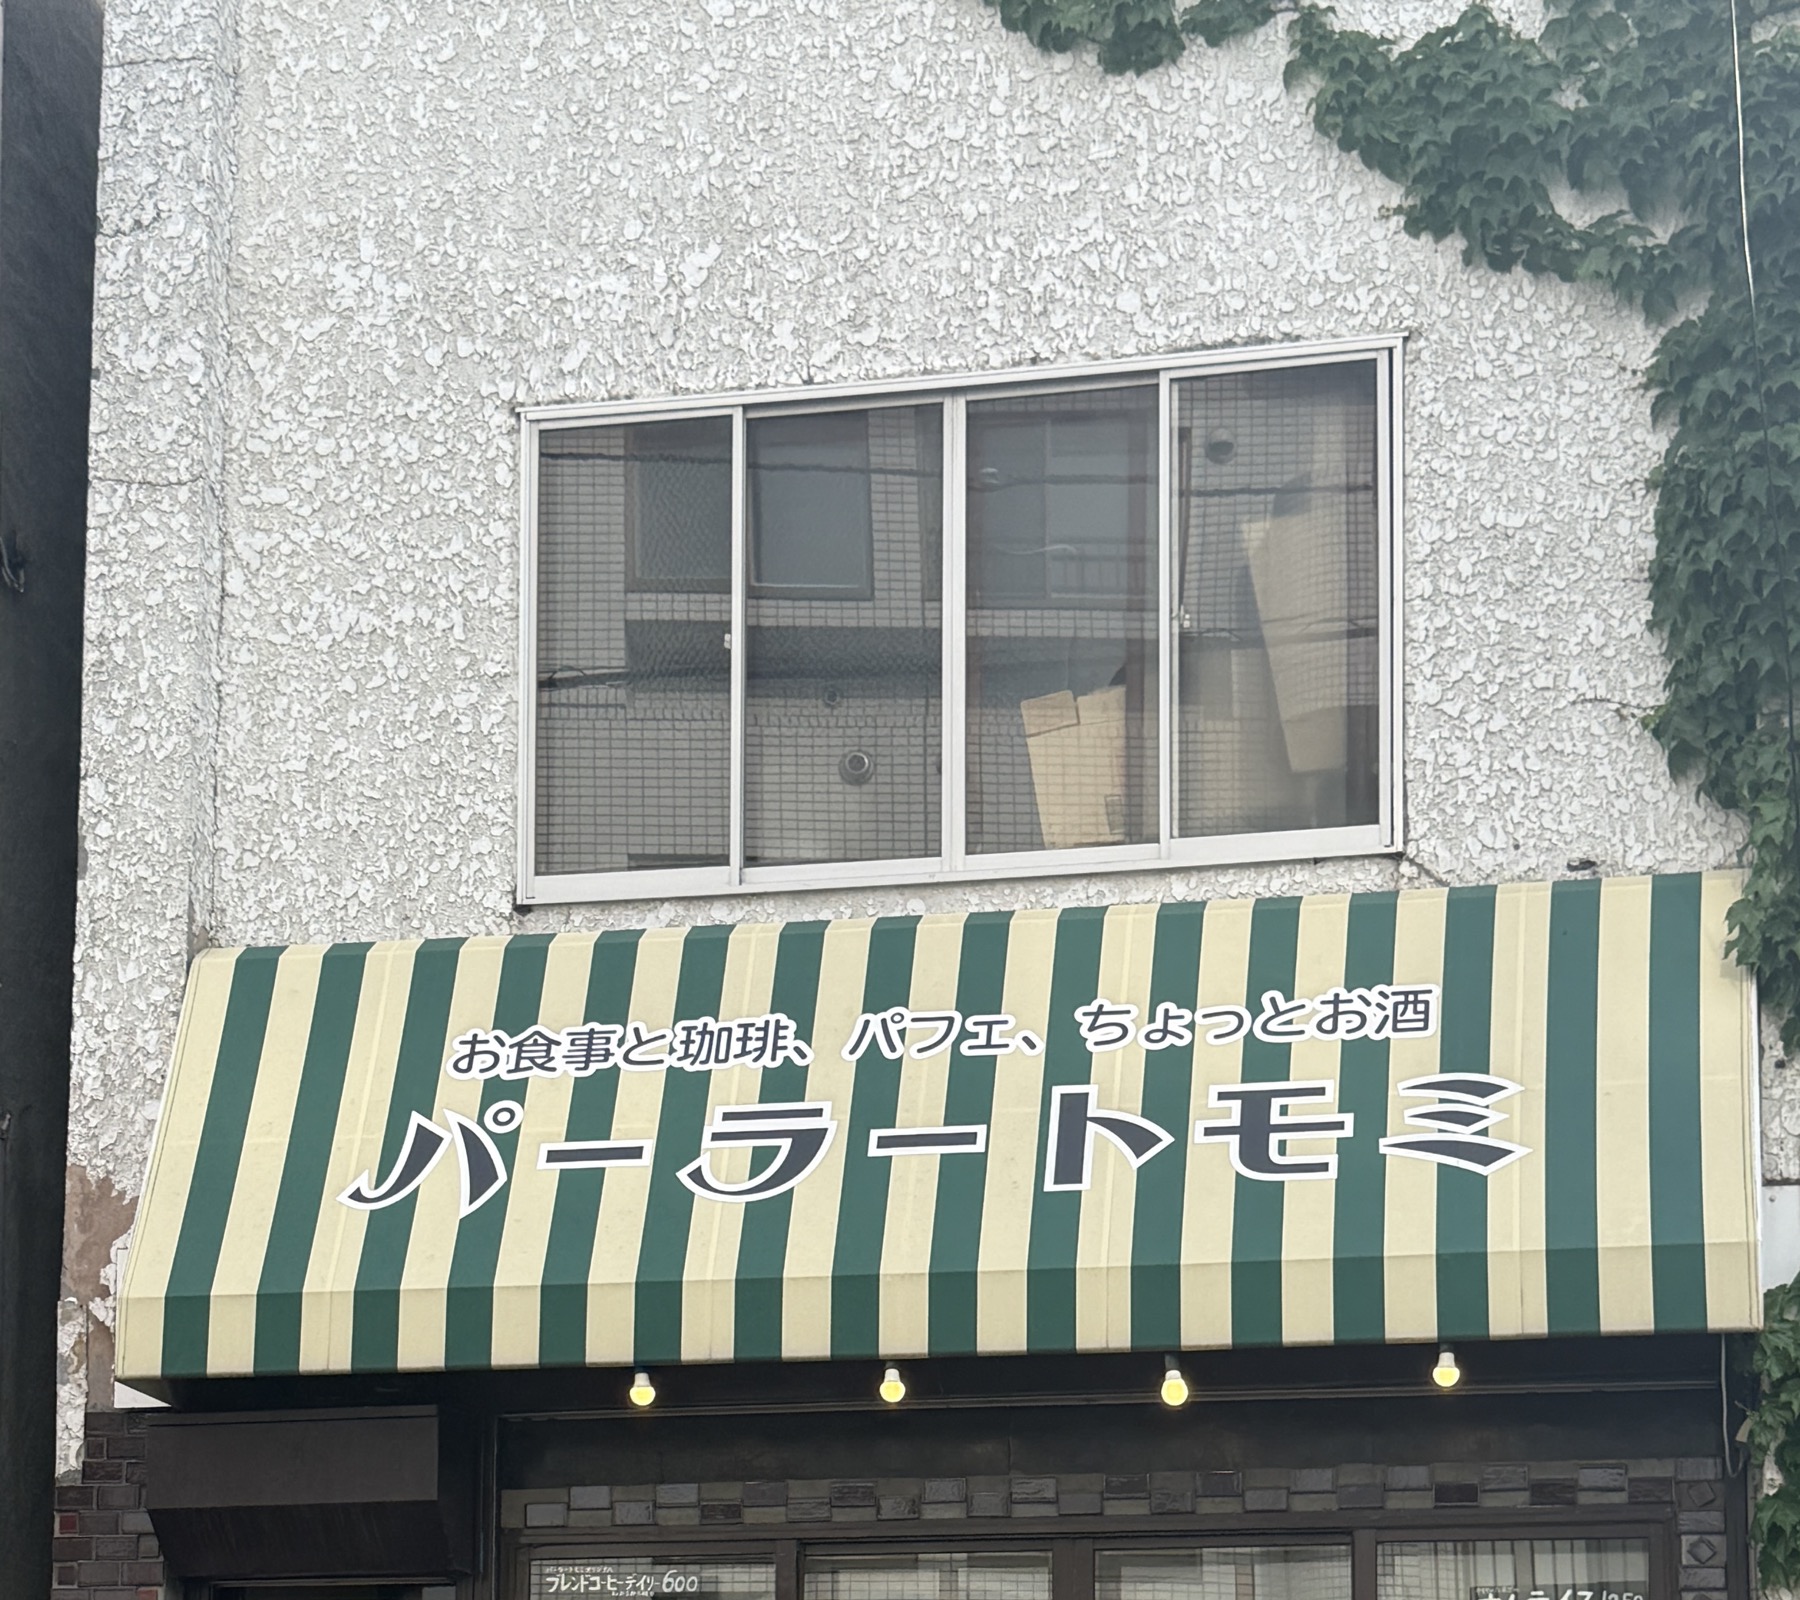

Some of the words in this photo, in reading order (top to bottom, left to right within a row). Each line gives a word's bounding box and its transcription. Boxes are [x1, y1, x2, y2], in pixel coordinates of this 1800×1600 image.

[338, 1072, 1535, 1217] パーラートモミ
[662, 1569, 698, 1592] 600
